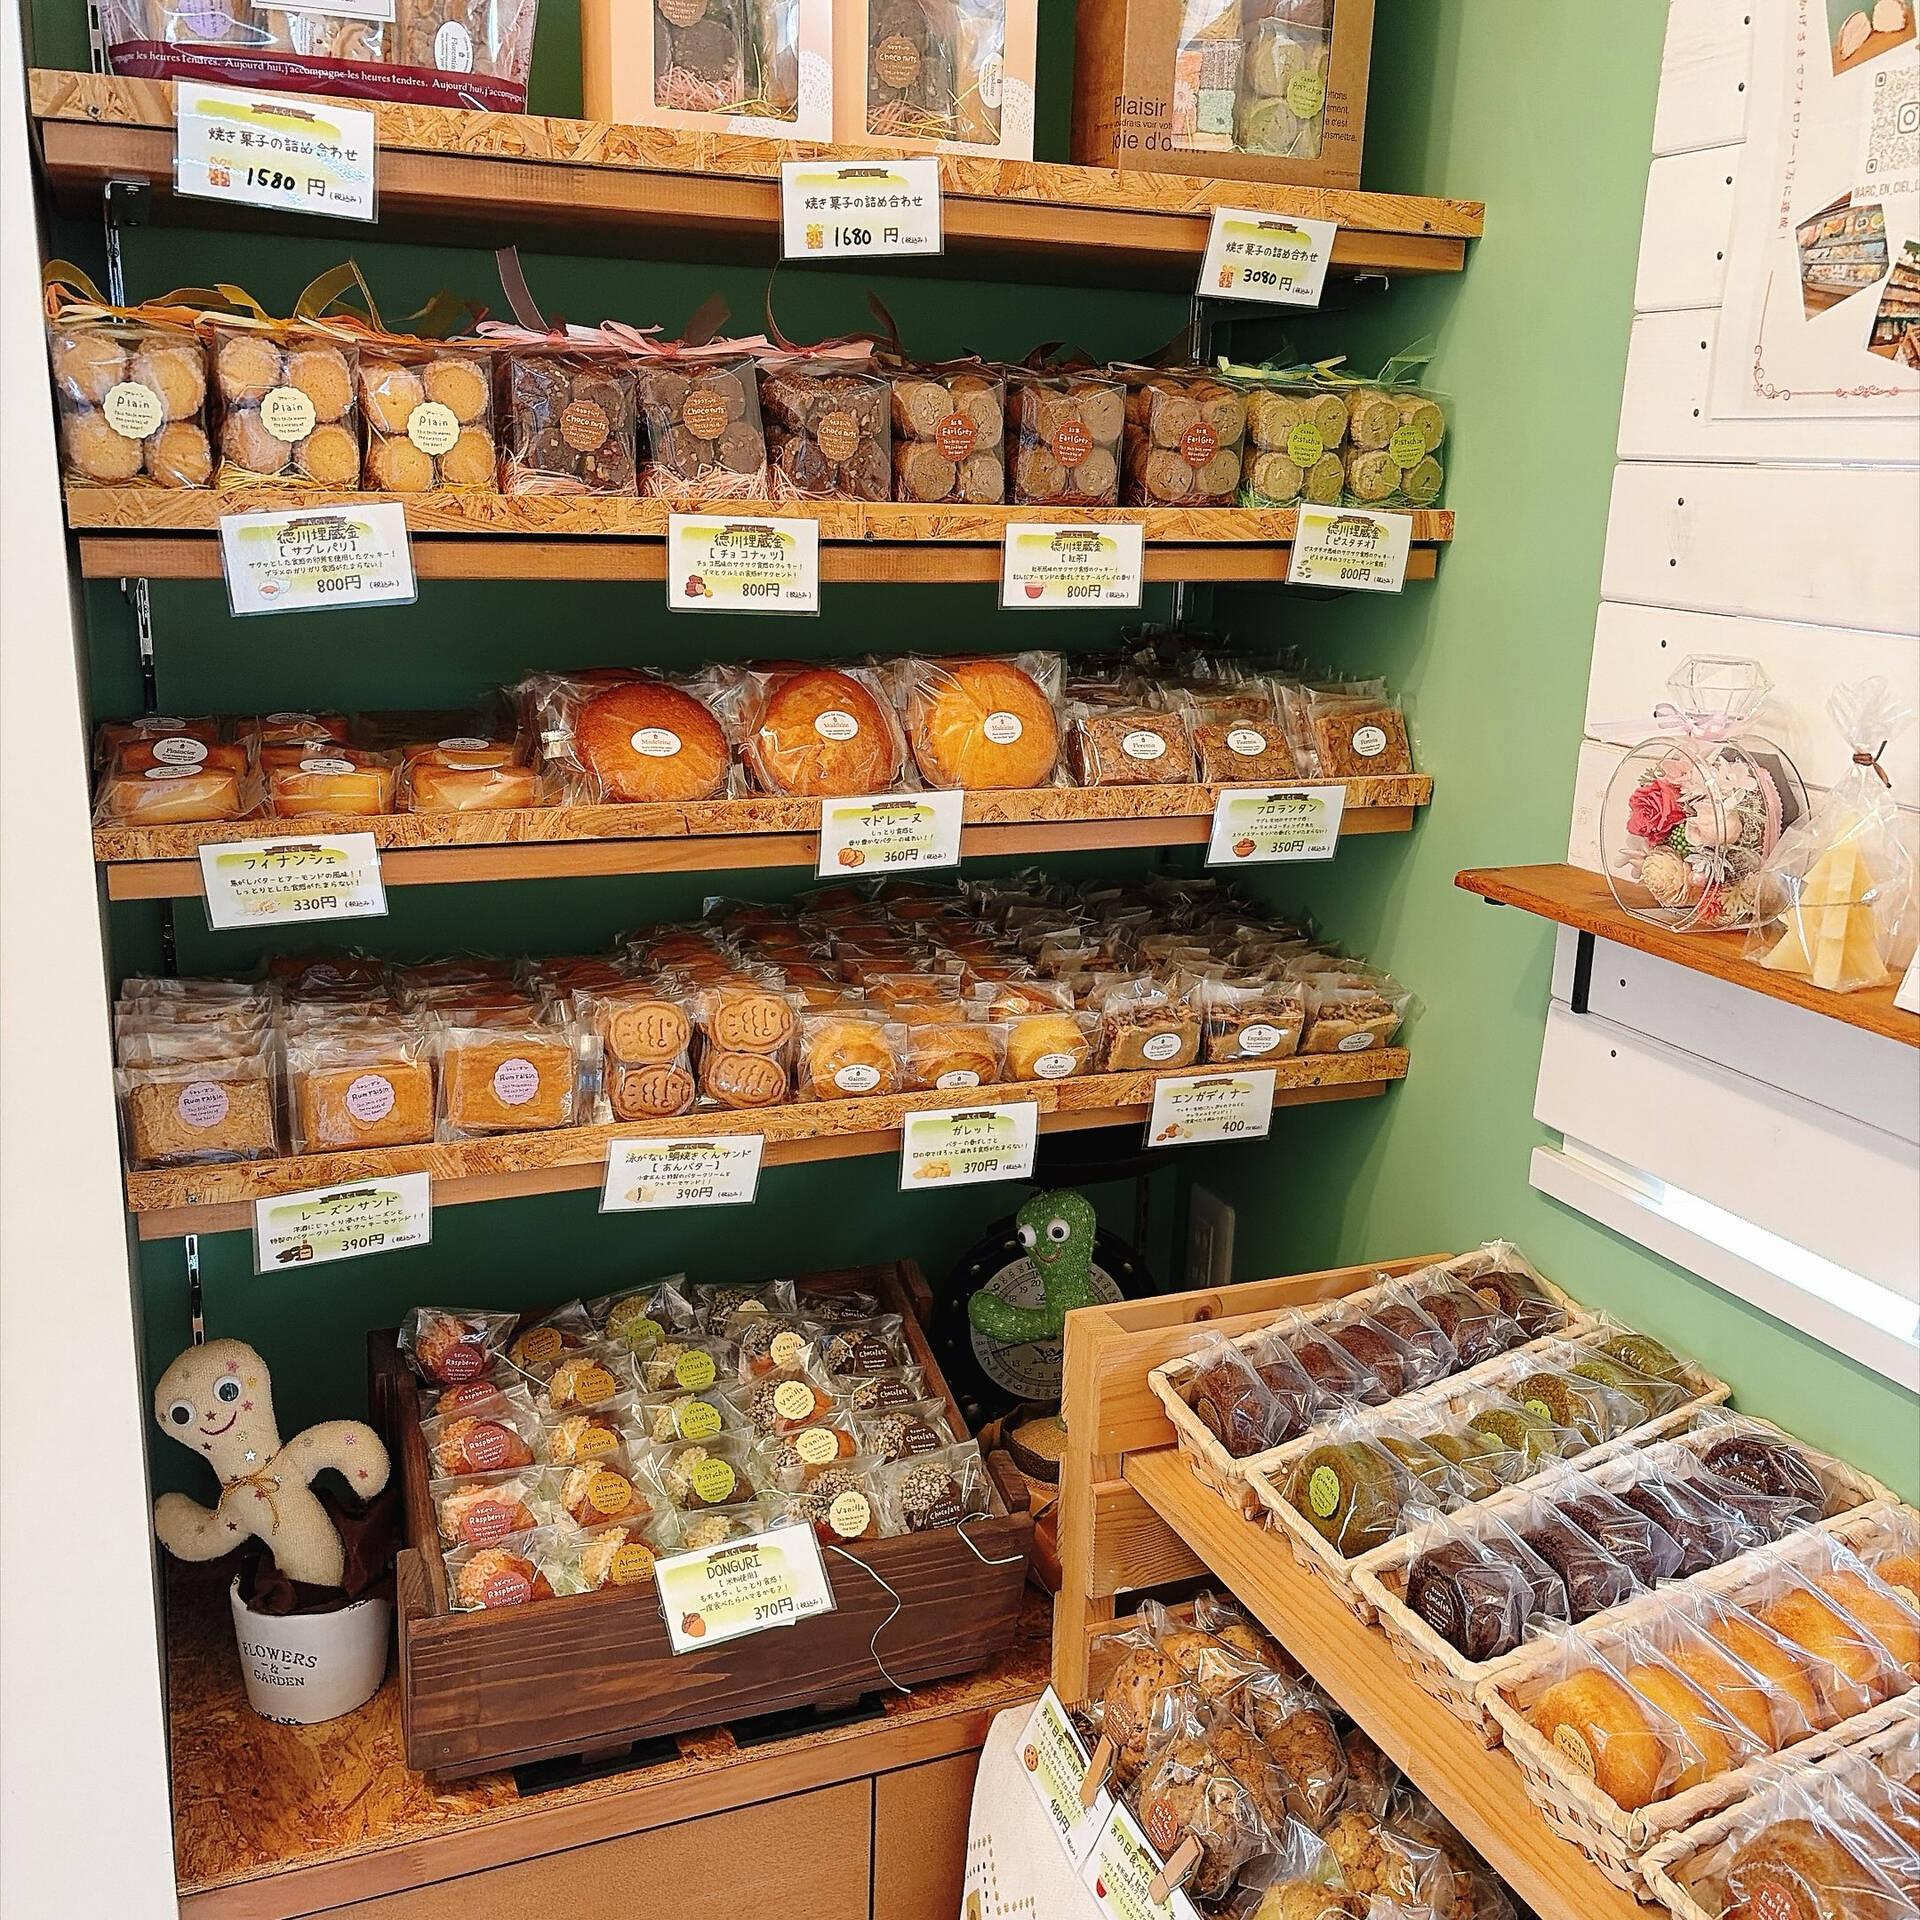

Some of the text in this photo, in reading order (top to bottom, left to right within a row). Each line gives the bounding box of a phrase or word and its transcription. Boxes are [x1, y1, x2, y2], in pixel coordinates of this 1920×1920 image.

[149, 51, 181, 62] heures
[361, 71, 391, 83] heures
[1113, 96, 1167, 117] Plaisir
[247, 167, 296, 191] 1580
[805, 195, 924, 210] 焼き菓子の詰め合わせ
[834, 226, 872, 247] 1680
[1225, 241, 1319, 263] 焼き菓子の詰め合わせ
[1242, 268, 1277, 287] 3080
[117, 395, 150, 409] Plain
[272, 401, 304, 413] Plain
[419, 415, 449, 427] Plain
[565, 414, 590, 426] Choco
[942, 427, 957, 437] Earl
[1059, 433, 1073, 443] Earl
[276, 524, 361, 545] 徳川埋蔵金
[1327, 522, 1382, 540] 徳川埋蔵金
[714, 533, 785, 549] 徳川埋蔵金
[1050, 540, 1104, 552] 徳川埋蔵金
[1340, 567, 1371, 581] 800円
[317, 574, 361, 594] 800円
[742, 582, 780, 598] 800円
[1067, 584, 1101, 598] 800円
[1257, 803, 1317, 815] フロランタン
[860, 812, 922, 827] マドレーヌ
[1270, 840, 1305, 853] 350円
[243, 854, 337, 870] フィナンシェ
[883, 848, 919, 862] 360円
[293, 895, 337, 911] 330円
[183, 1093, 224, 1106] Rum raisin
[352, 1086, 389, 1102] Rum raisin
[1171, 1088, 1251, 1104] エンガディナー
[952, 1123, 995, 1136] ガレット
[1222, 1120, 1245, 1133] 400
[963, 1158, 998, 1174] 370円
[675, 1186, 713, 1199] 390円
[301, 1195, 398, 1221] レーズンサンド
[341, 1233, 385, 1252] 390円
[445, 1358, 479, 1368] Raspberry
[458, 1386, 494, 1403] Raspberry
[468, 1434, 505, 1450] Raspberry
[582, 1439, 612, 1451] Almond
[594, 1481, 625, 1493] Almond
[835, 1503, 865, 1515] Vanilla
[469, 1512, 506, 1526] Raspberry
[618, 1556, 649, 1569] Almond
[706, 1553, 762, 1580] DONGURI
[487, 1582, 525, 1600] Raspberry
[753, 1596, 794, 1621] 370円
[241, 1641, 318, 1669] FLOWERS
[253, 1668, 305, 1687] GARDEN
[1049, 1797, 1071, 1836] 480円
